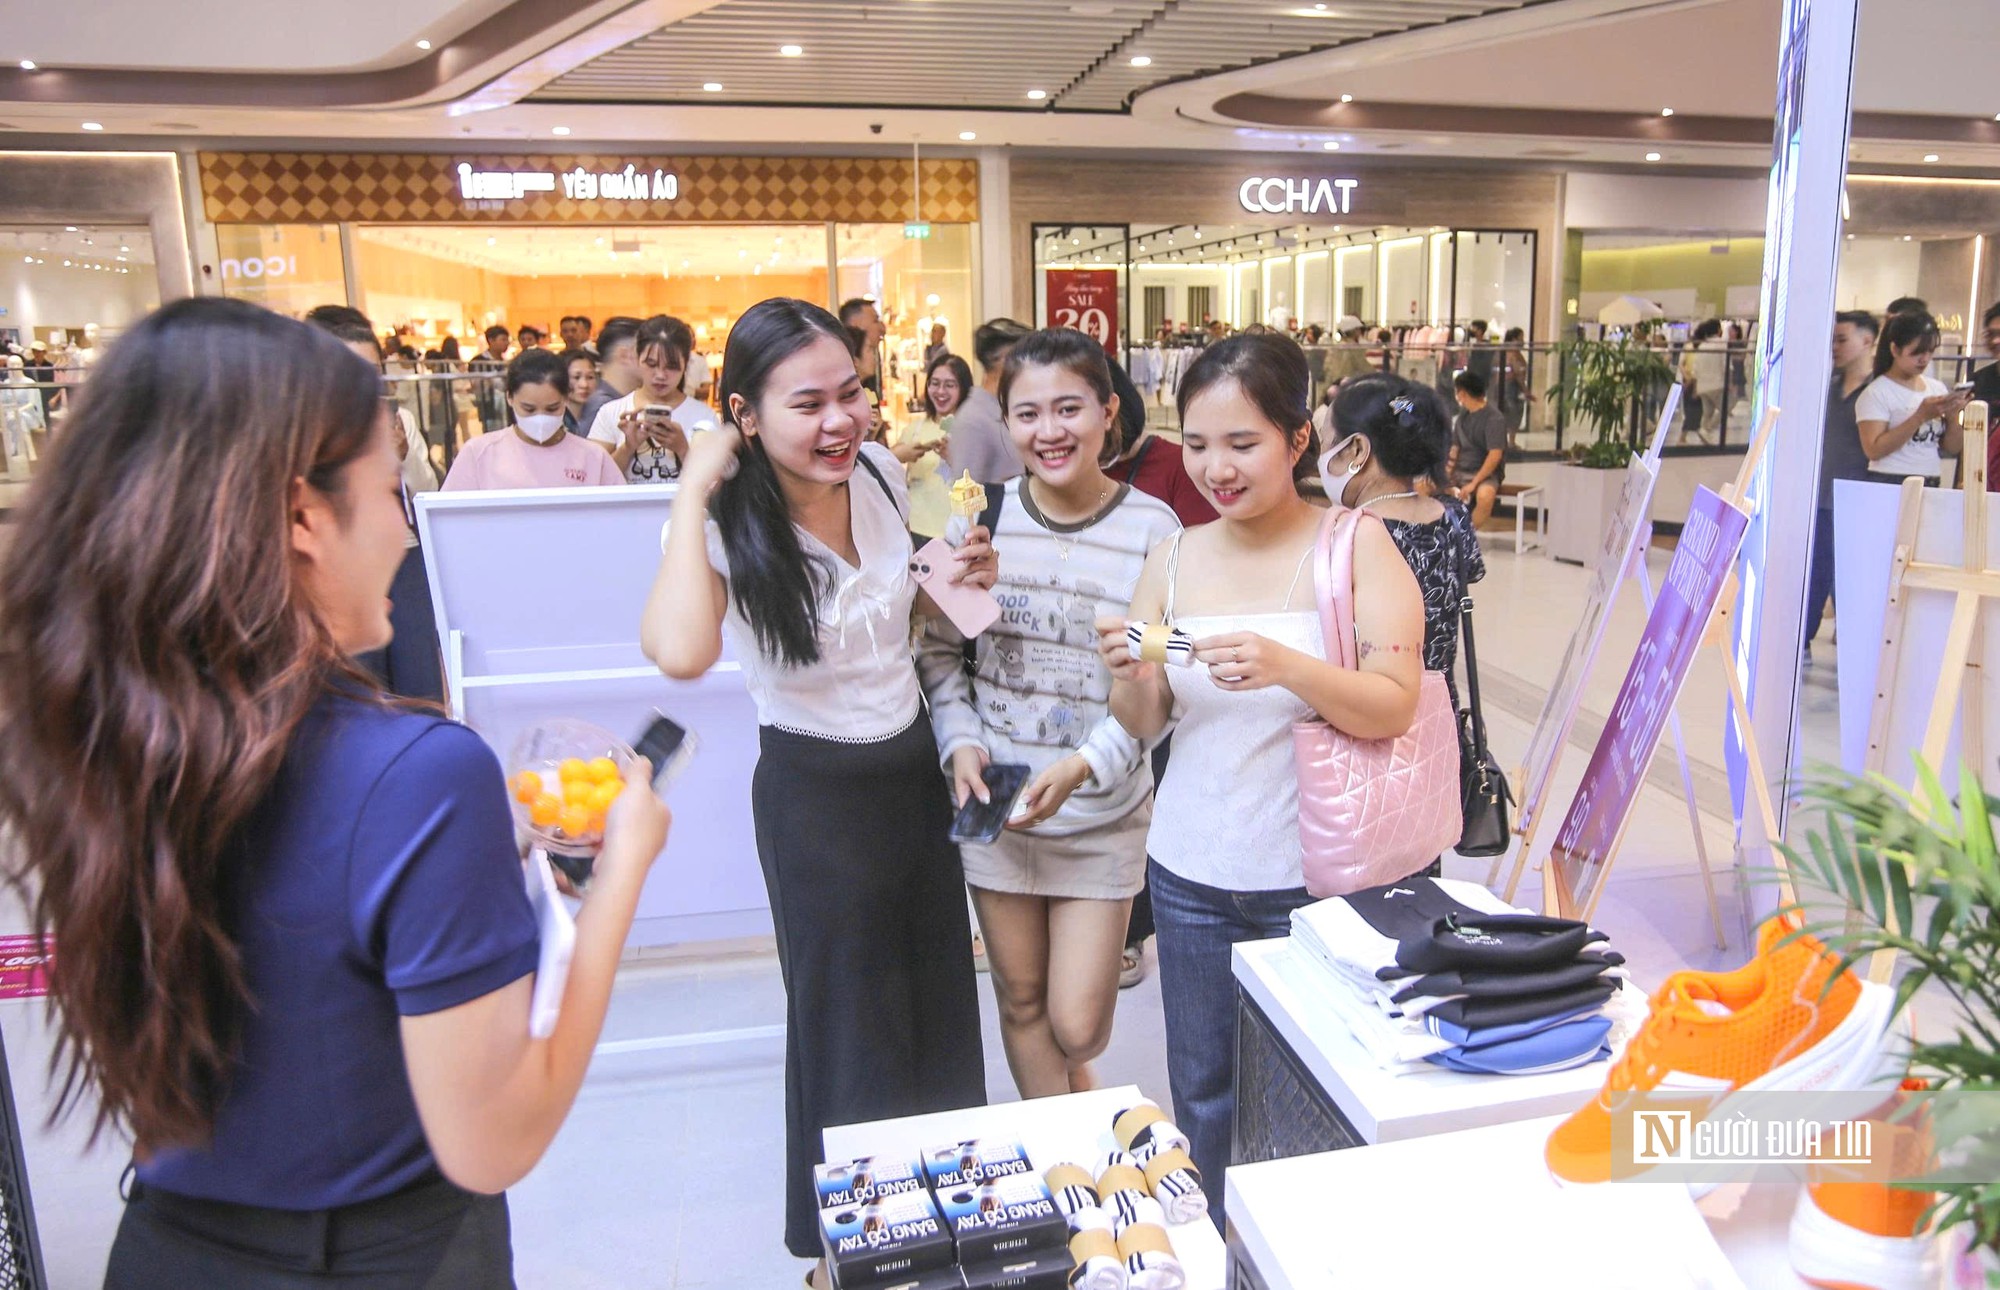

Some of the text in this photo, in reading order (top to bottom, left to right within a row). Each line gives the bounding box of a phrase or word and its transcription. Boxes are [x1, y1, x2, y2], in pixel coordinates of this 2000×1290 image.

[1682, 508, 1720, 564] GRAND
[1668, 546, 1711, 614] OPENING
[997, 594, 1029, 608] OOD
[1001, 611, 1041, 632] LUCK
[937, 1171, 963, 1187] TAY
[827, 1189, 853, 1206] TAY
[957, 1213, 985, 1231] TAY
[838, 1234, 867, 1254] TAY
